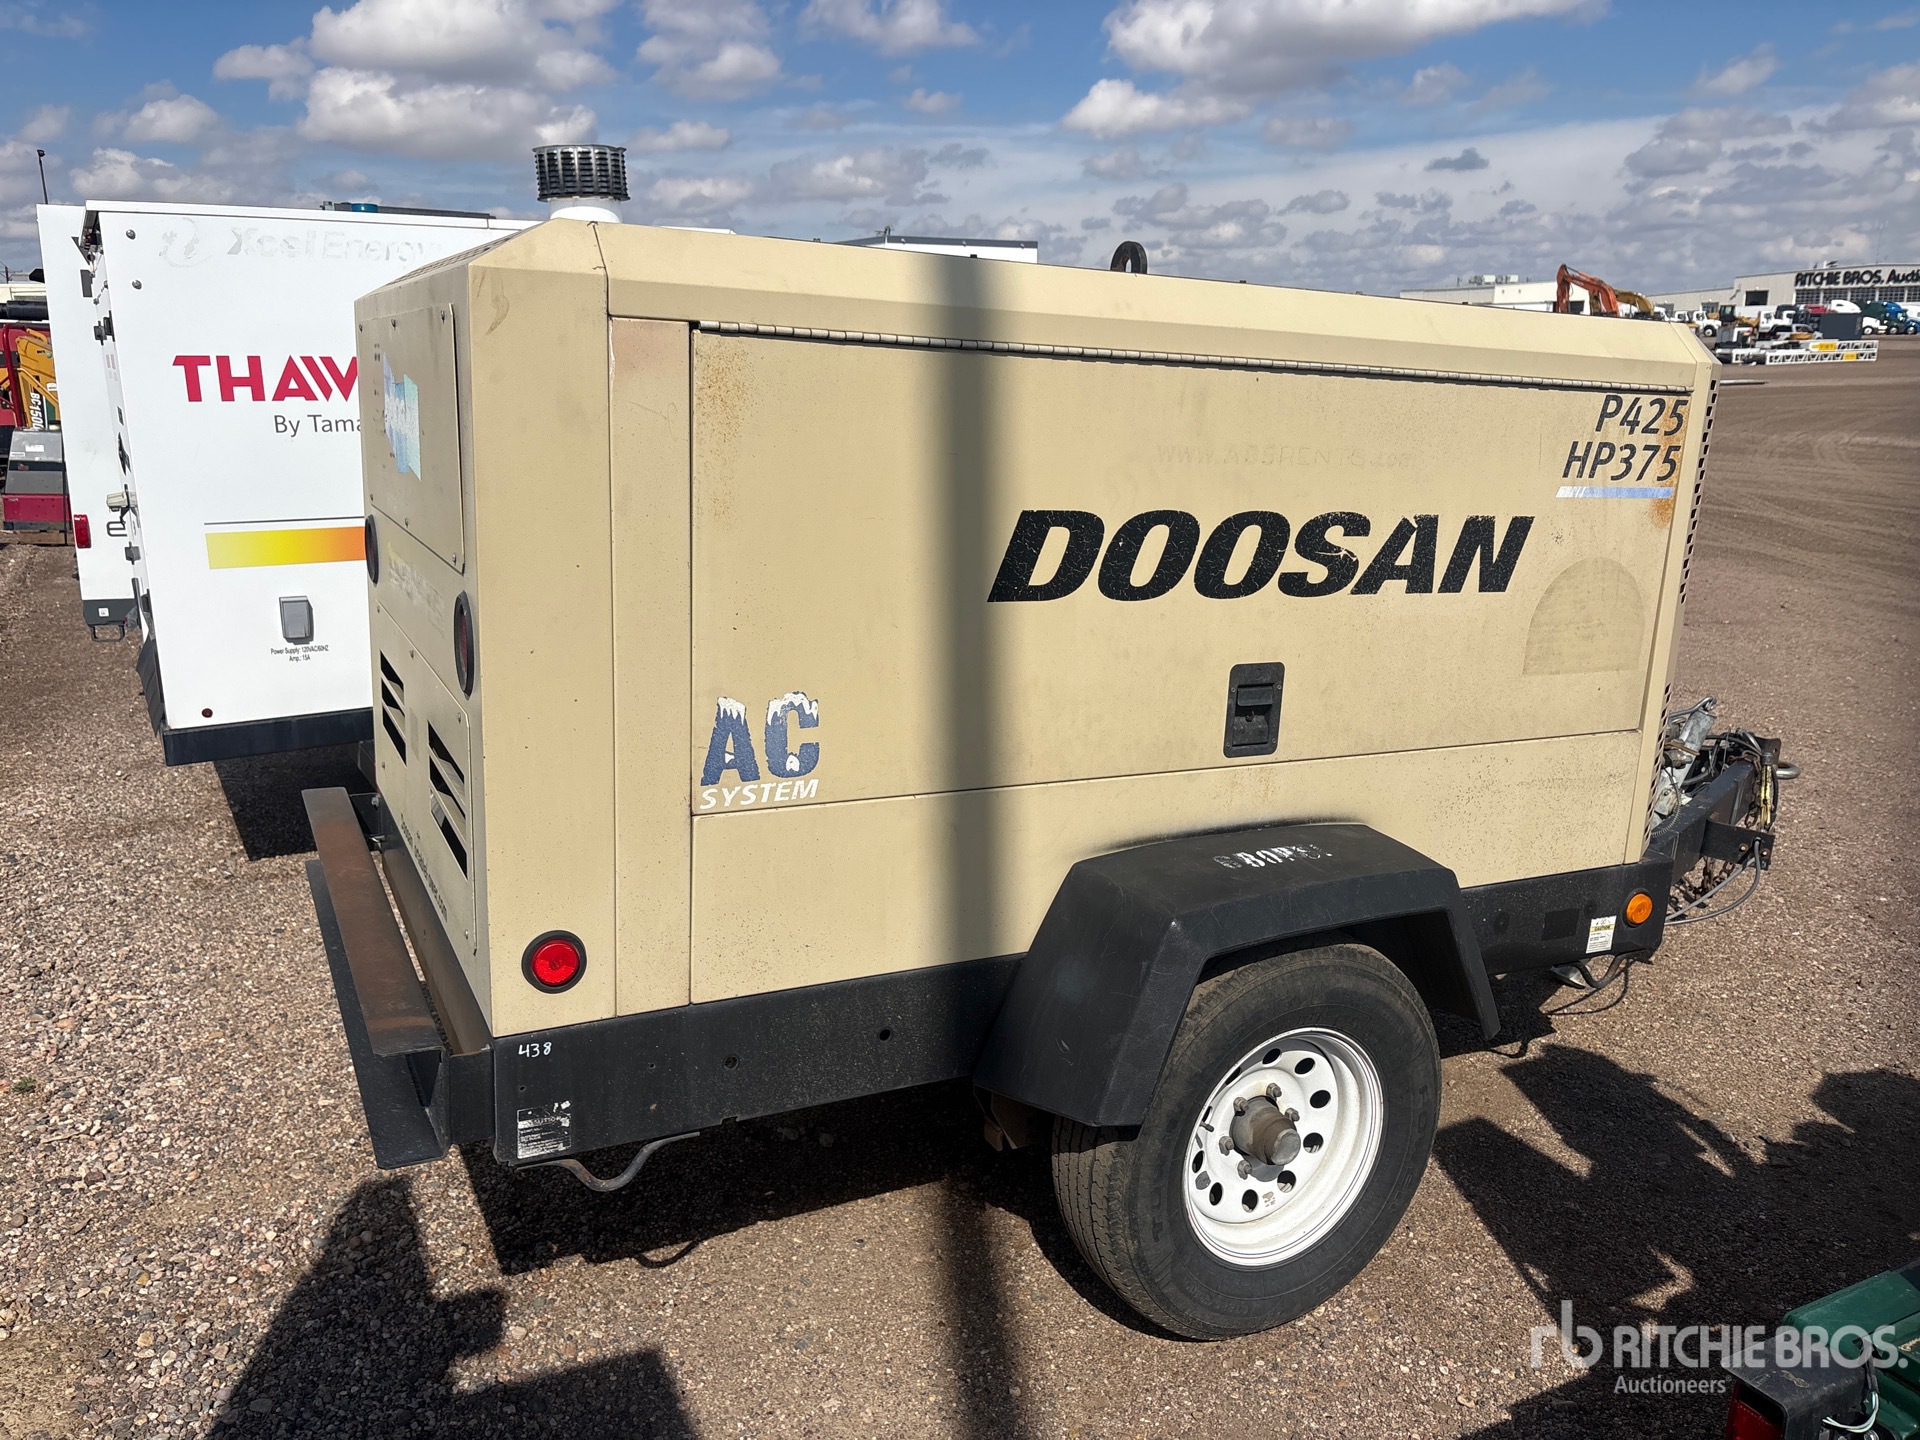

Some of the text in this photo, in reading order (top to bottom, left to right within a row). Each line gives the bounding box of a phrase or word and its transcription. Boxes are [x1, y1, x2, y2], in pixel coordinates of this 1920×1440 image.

[1795, 271, 1841, 286] RITCHIE
[274, 415, 300, 437] By
[1594, 394, 1689, 437] P425
[1562, 440, 1681, 483] HP375
[989, 510, 1533, 602] DOOSAN
[700, 690, 820, 786] AC
[699, 778, 820, 810] SYSTEM
[518, 1041, 553, 1058] 438
